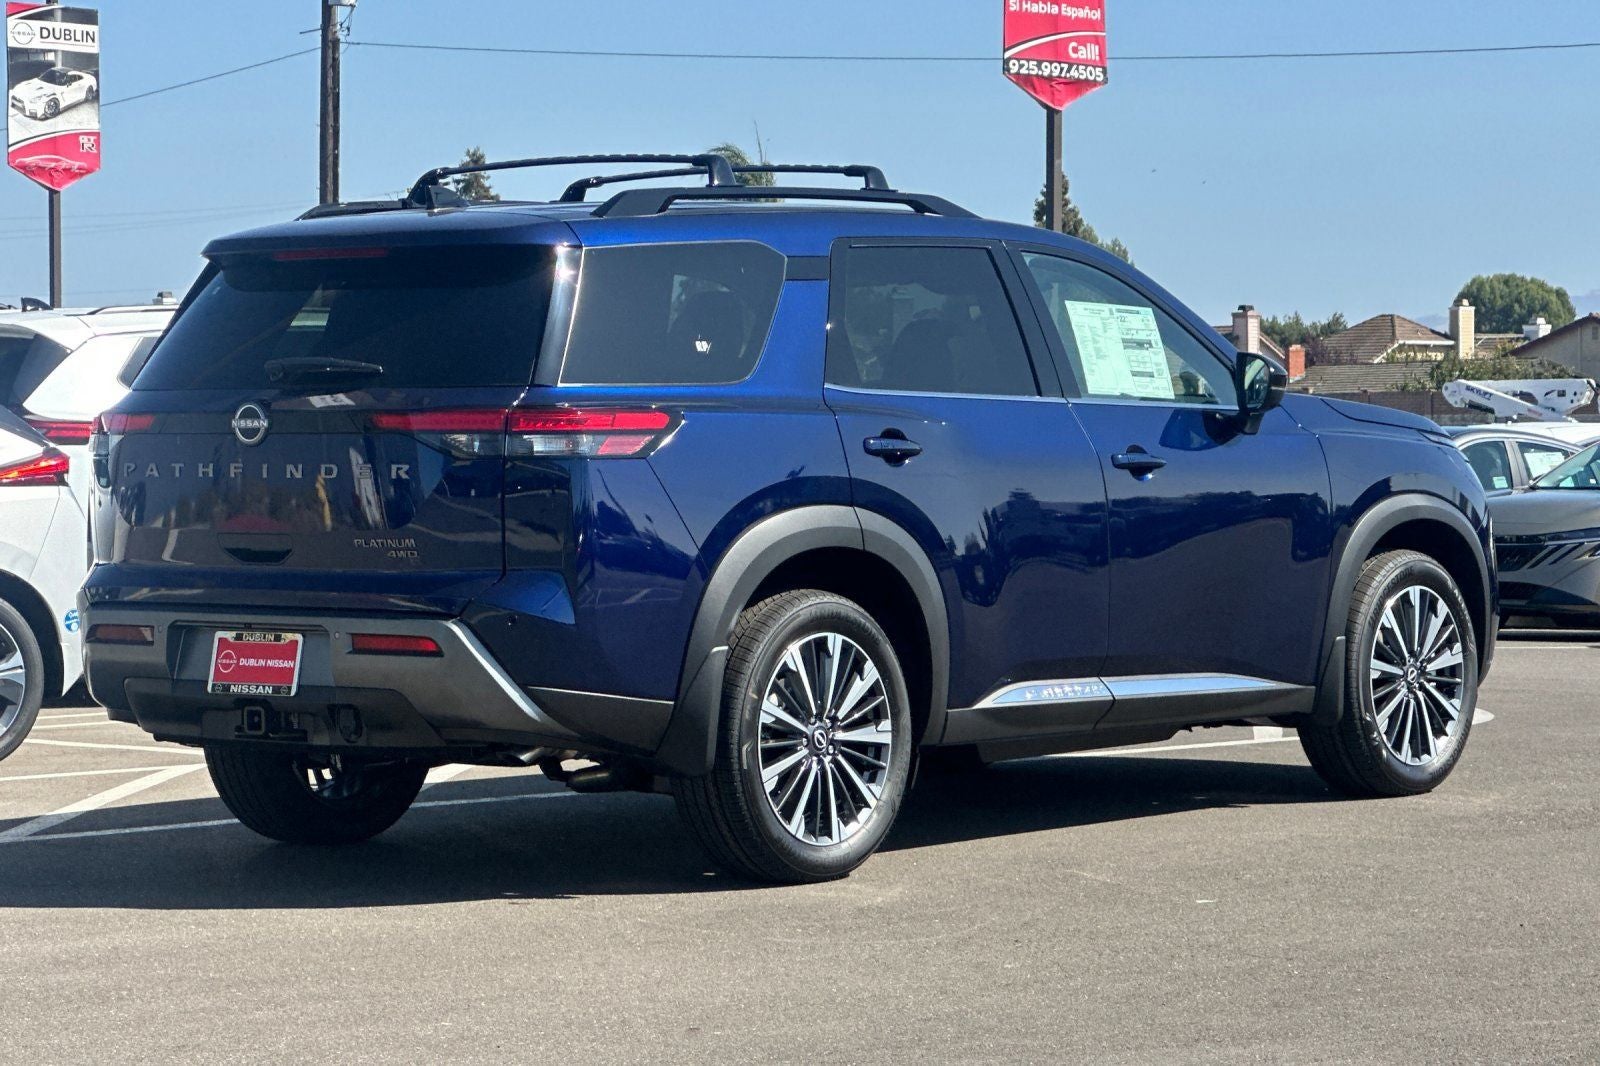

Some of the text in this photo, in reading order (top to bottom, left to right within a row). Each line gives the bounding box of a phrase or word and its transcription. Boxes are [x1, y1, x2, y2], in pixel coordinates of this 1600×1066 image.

[1022, 0, 1059, 14] Habla
[1061, 4, 1101, 20] Español
[40, 26, 96, 43] DUBLIN
[1068, 41, 1100, 60] Call!
[1008, 59, 1104, 82] 925.997.4505
[231, 419, 268, 428] NISSAN
[123, 462, 411, 480] PATHFINDER
[354, 538, 416, 548] PLATINUM
[387, 550, 418, 558] 4WD
[242, 633, 275, 642] DUBLIN
[239, 658, 295, 668] DUBLIN NISSAN
[229, 684, 273, 694] NISSAN
